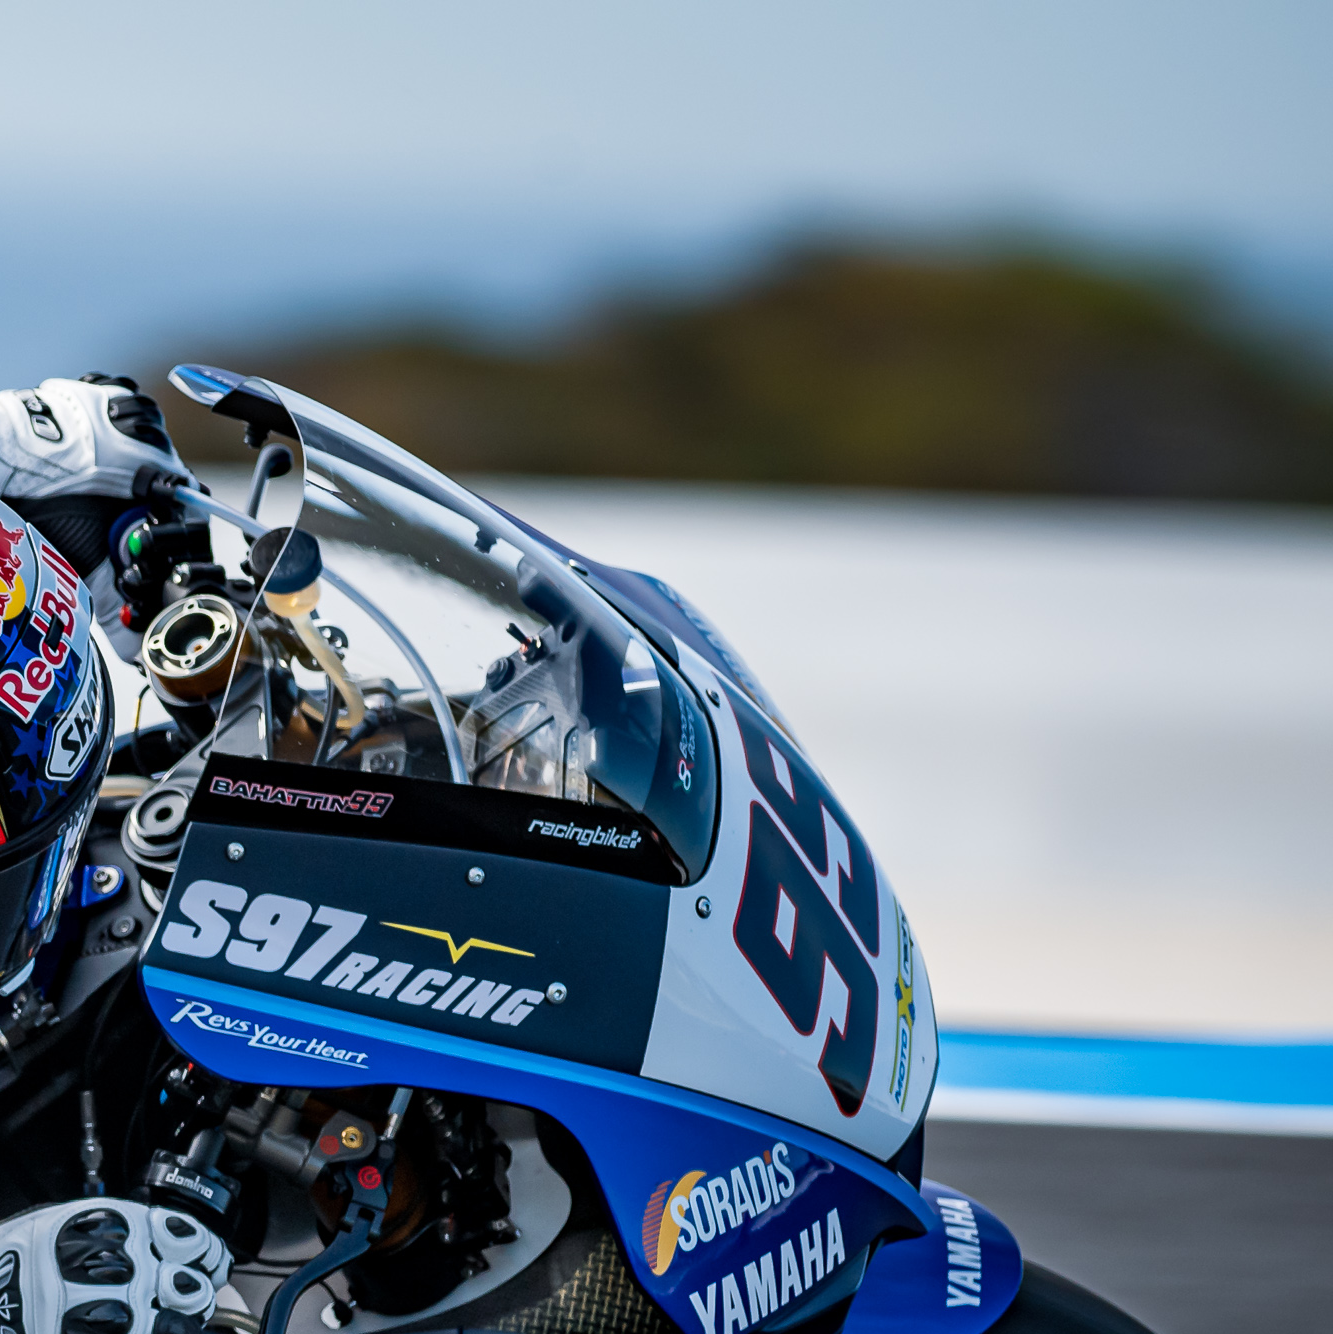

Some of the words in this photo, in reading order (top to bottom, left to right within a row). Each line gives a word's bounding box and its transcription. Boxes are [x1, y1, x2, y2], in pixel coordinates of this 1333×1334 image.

[39, 540, 81, 641] Bull
[209, 776, 395, 818] BAHATTIN99
[712, 671, 879, 1118] 99
[160, 879, 368, 981] S97
[321, 951, 545, 1027] RACING
[170, 998, 251, 1040] Revs
[247, 1021, 306, 1051] Your
[305, 1038, 370, 1067] Heart
[165, 1167, 214, 1199] domino
[936, 1196, 982, 1307] YAMAHA
